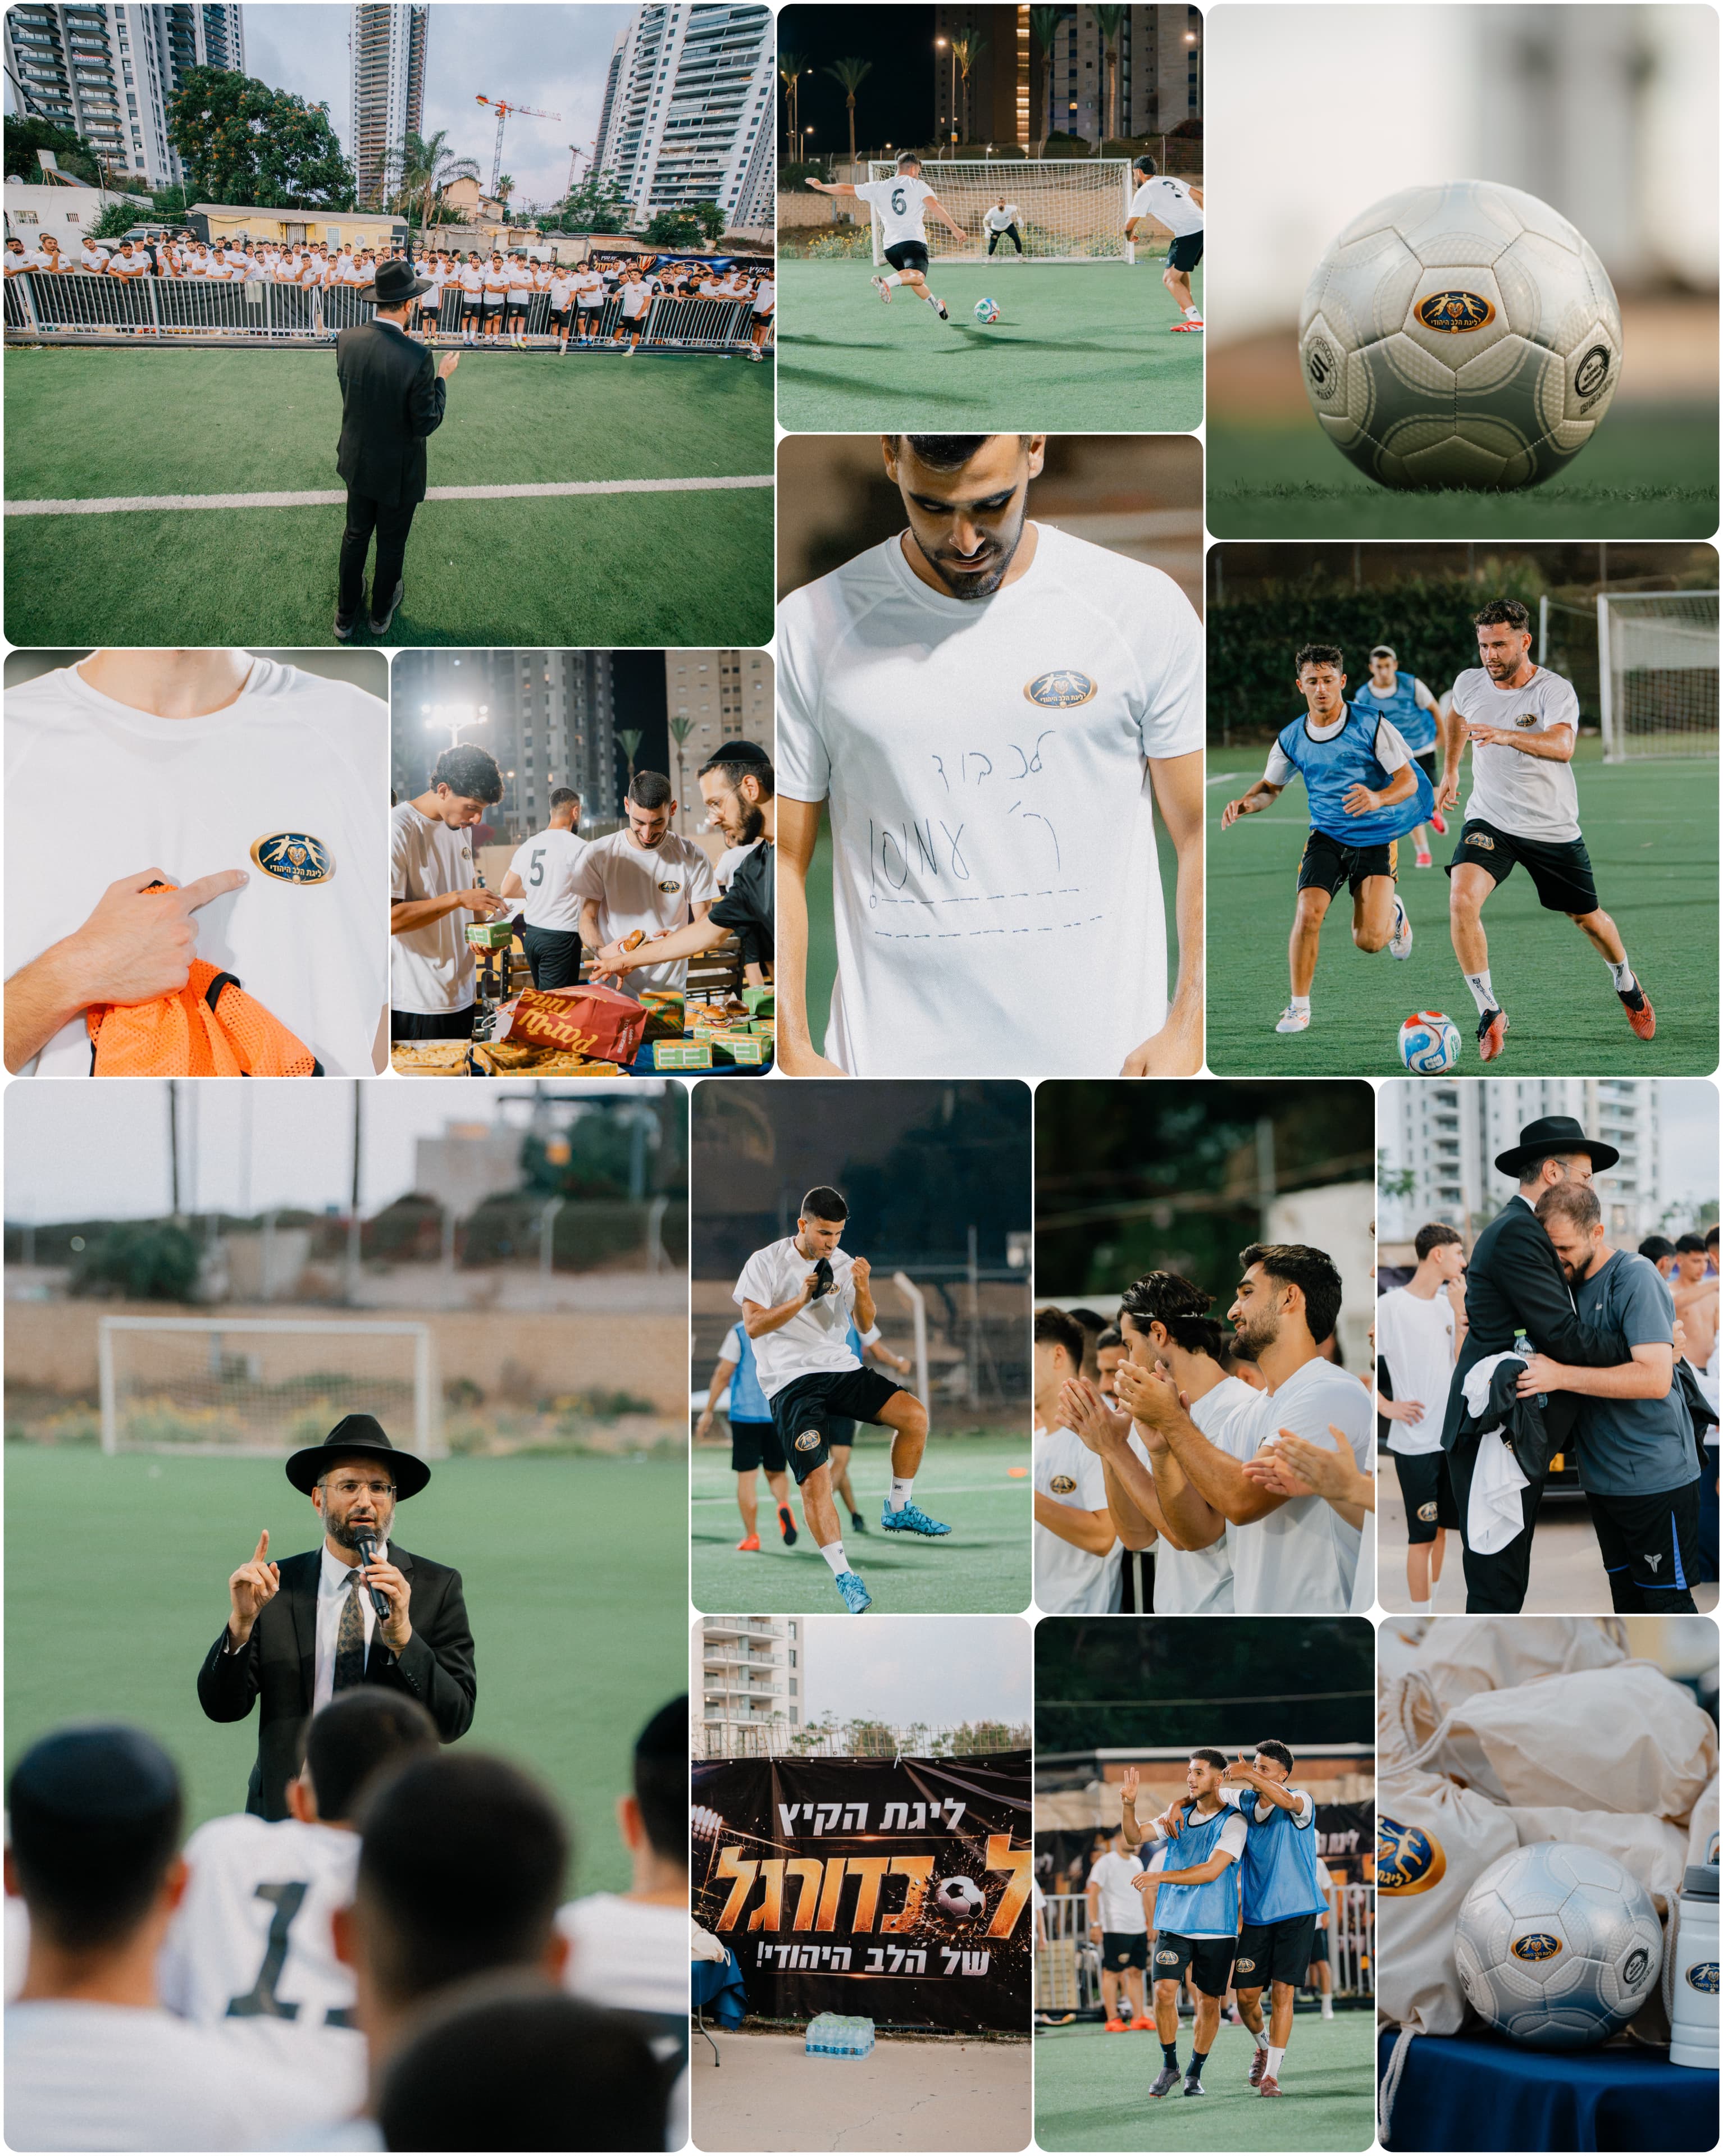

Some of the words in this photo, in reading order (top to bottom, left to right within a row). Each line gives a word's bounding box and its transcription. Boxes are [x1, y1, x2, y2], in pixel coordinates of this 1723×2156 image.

[892, 188, 907, 216] 6
[270, 865, 291, 874] היהודי
[293, 866, 305, 875] הלב
[306, 869, 322, 878] ליגת
[530, 849, 546, 887] 5
[778, 1803, 869, 1837] הקיץ
[879, 1798, 966, 1830] ליגת
[756, 1942, 853, 1971] היהודי!
[864, 1944, 927, 1975] הלב
[940, 1946, 990, 1976] של
